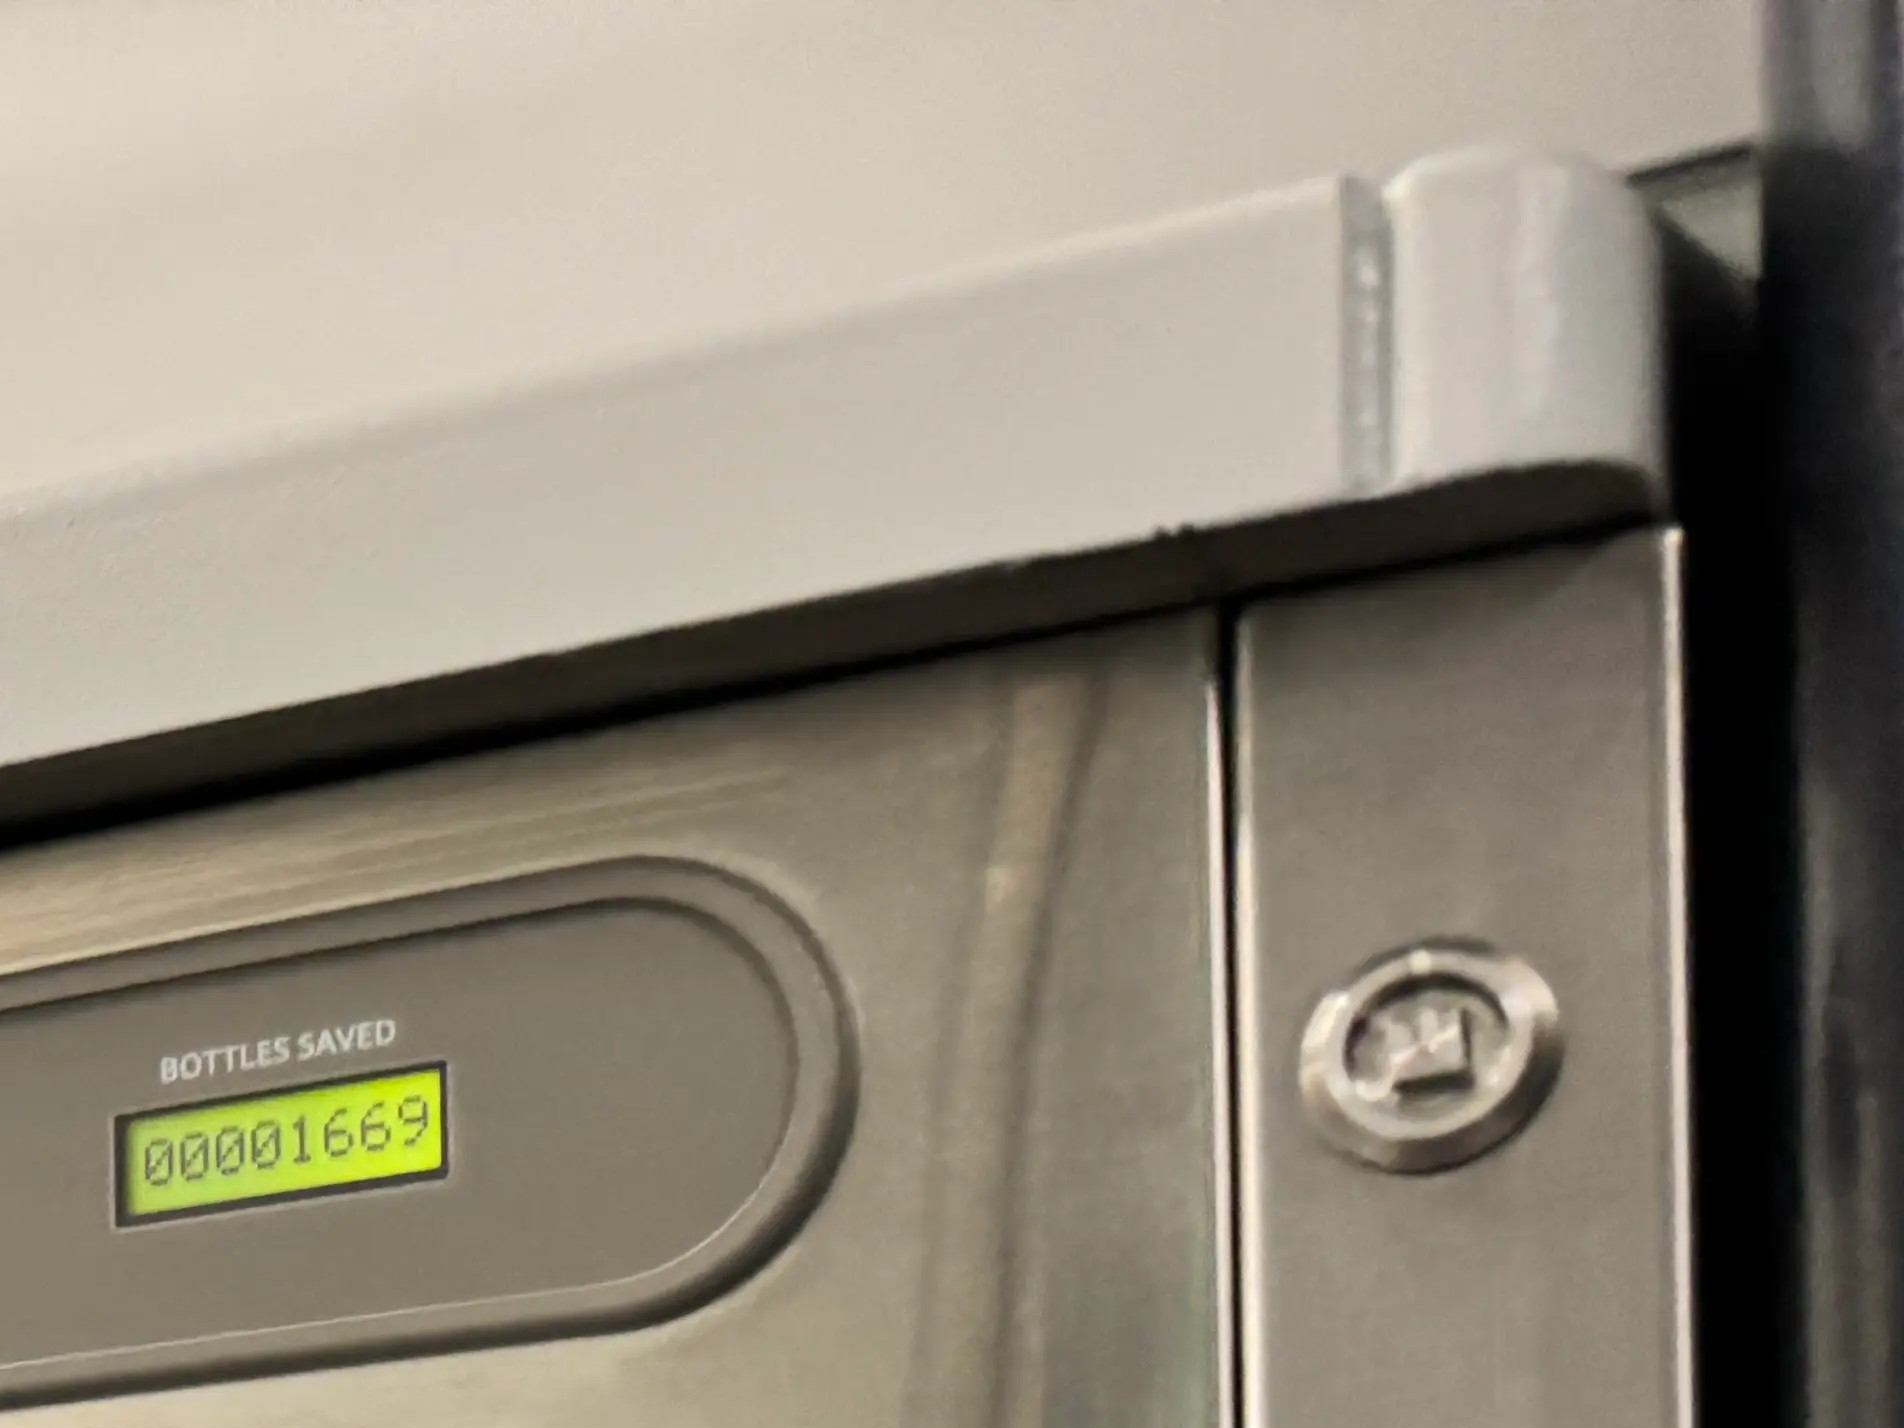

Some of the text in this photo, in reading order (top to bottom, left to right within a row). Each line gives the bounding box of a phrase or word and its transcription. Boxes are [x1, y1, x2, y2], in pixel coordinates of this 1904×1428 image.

[159, 1018, 397, 1085] BOTTLES SAVED
[143, 1094, 429, 1188] 00001669
